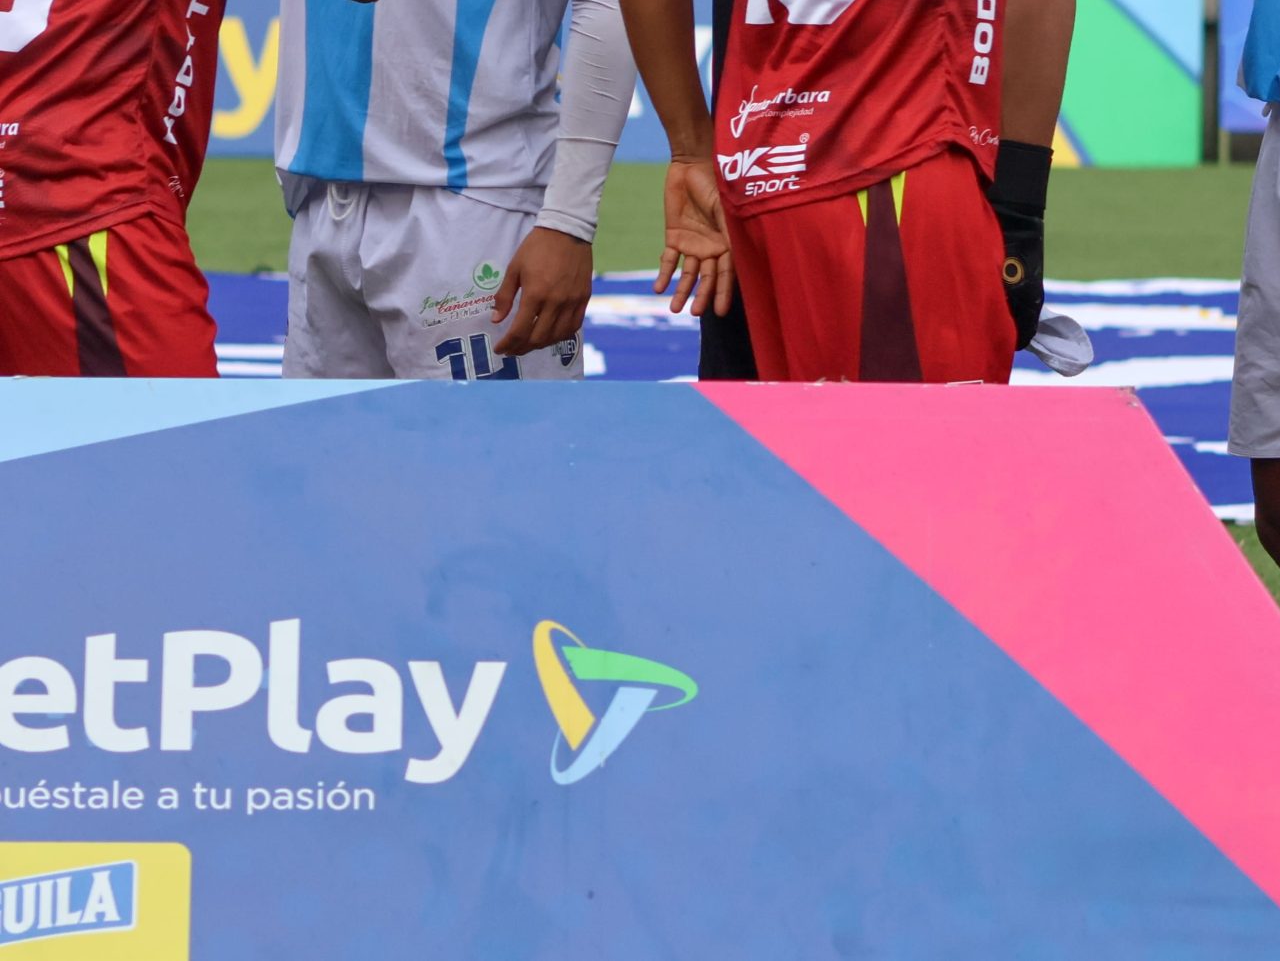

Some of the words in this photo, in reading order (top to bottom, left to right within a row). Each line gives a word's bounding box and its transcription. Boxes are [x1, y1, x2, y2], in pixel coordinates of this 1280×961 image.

[745, 175, 801, 196] sport
[0, 779, 145, 809] uéstale
[157, 786, 180, 810] a
[193, 783, 232, 810] tu
[246, 780, 376, 815] pasión
[0, 870, 121, 934] UILA
